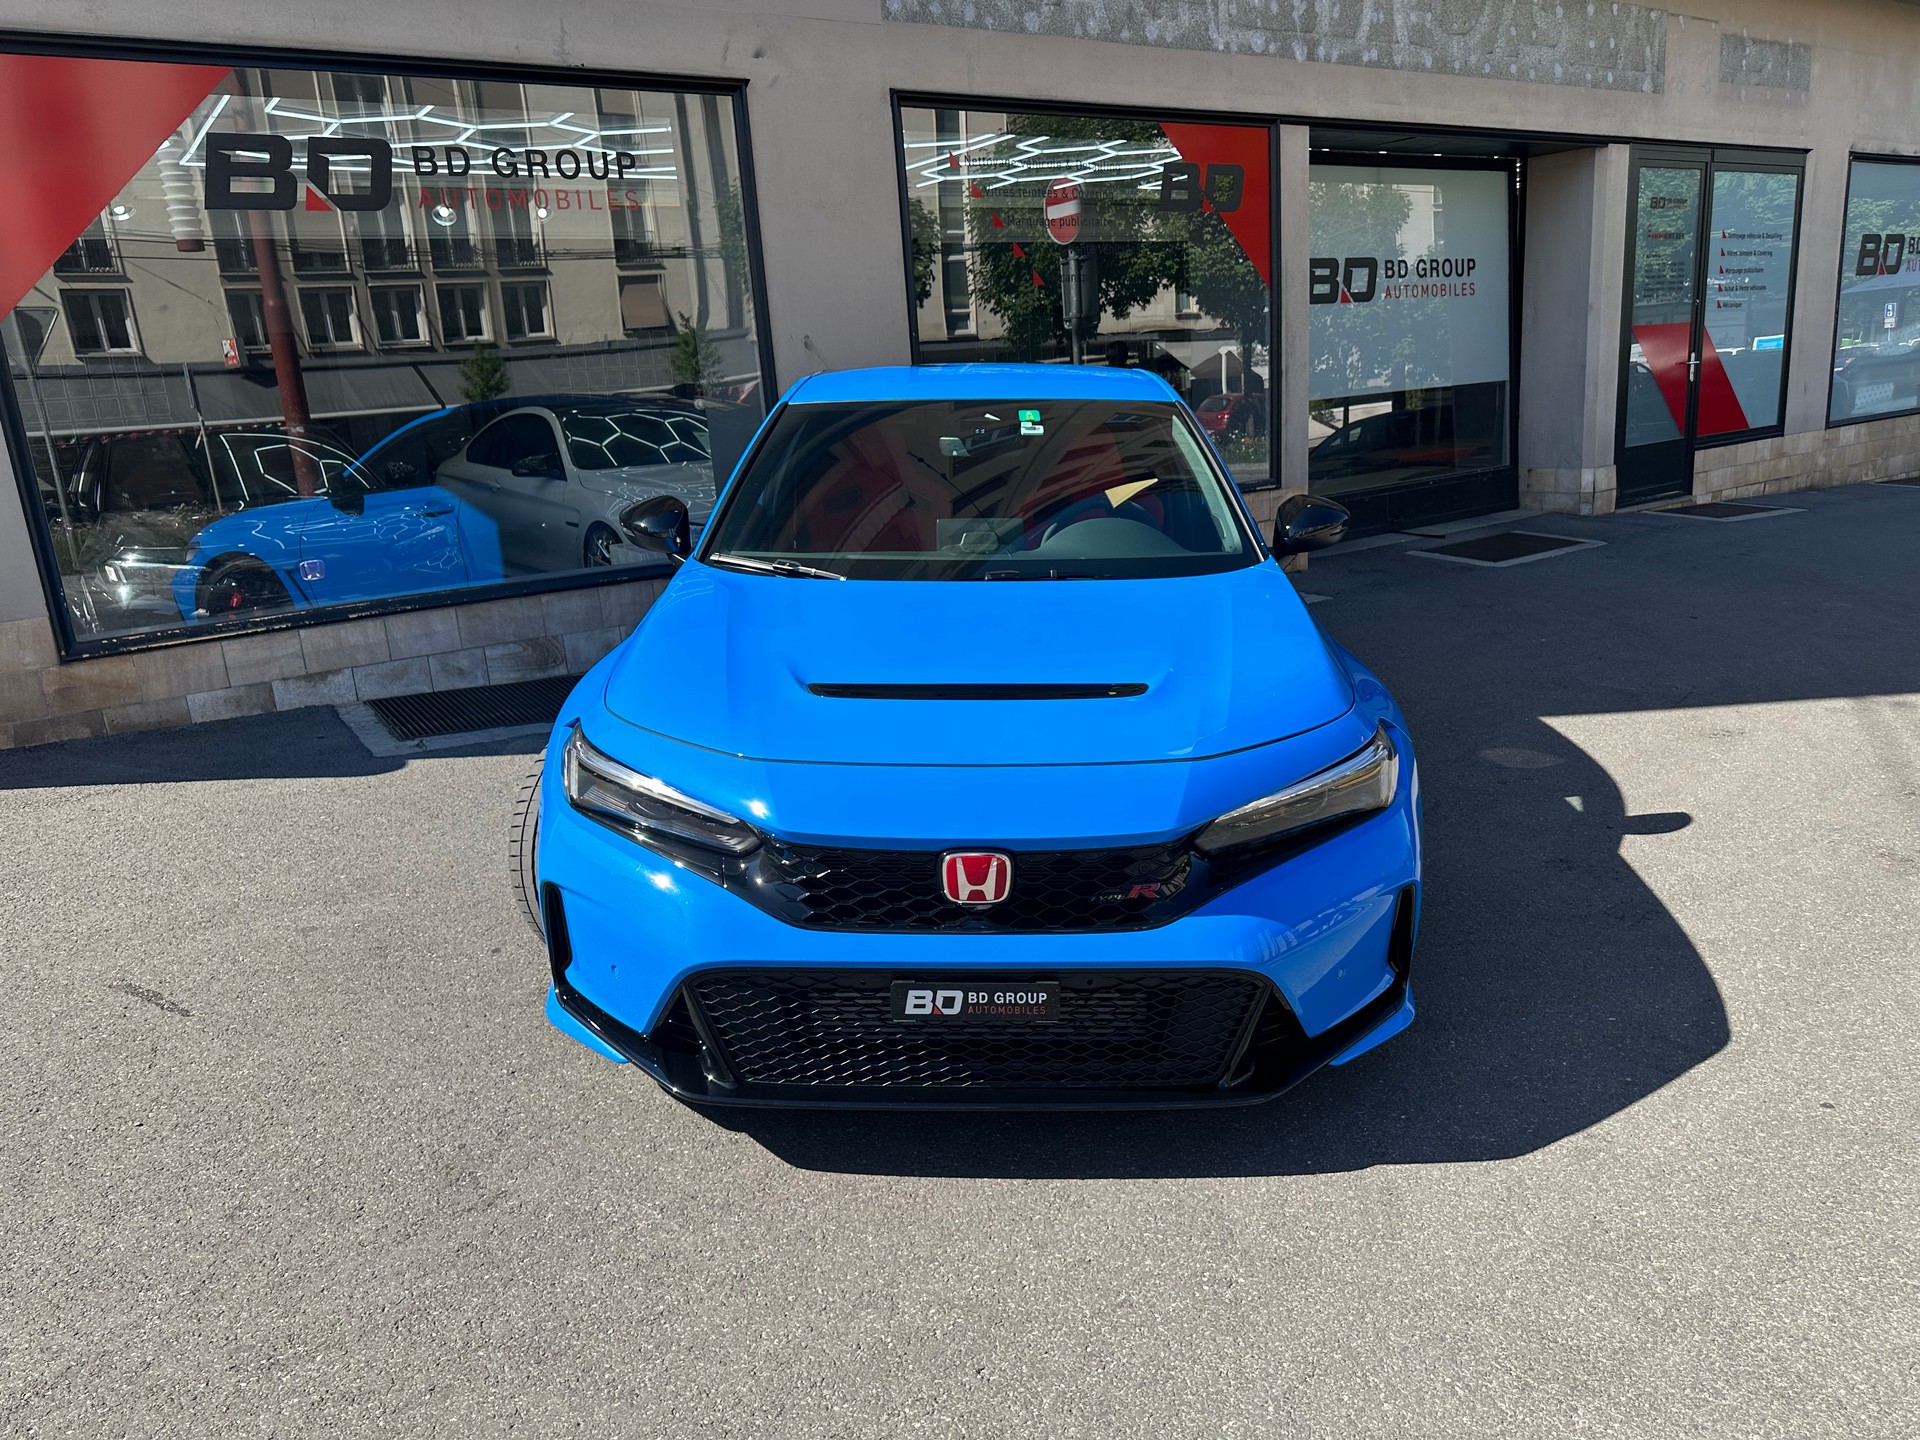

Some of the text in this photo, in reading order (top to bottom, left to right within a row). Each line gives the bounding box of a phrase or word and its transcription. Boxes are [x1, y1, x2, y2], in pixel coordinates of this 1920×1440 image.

[204, 132, 392, 211] BD
[411, 146, 636, 180] BD GROUP
[964, 155, 1016, 169] Nettoyage
[985, 185, 1014, 198] Vitres
[1062, 188, 1069, 199] &
[1160, 162, 1245, 212] BD
[419, 186, 640, 211] AUTOMOBILES
[1008, 215, 1112, 229] Marquage publicitaire
[1855, 233, 1905, 276] BD
[1384, 258, 1476, 279] BD GROUP
[1309, 257, 1378, 304] BD
[1384, 282, 1476, 299] AUTOMOBILES
[1126, 882, 1161, 900] R
[904, 989, 964, 1015] BD
[968, 992, 1047, 1004] BD GROUP
[967, 1005, 1046, 1015] AUTOMOBILES
